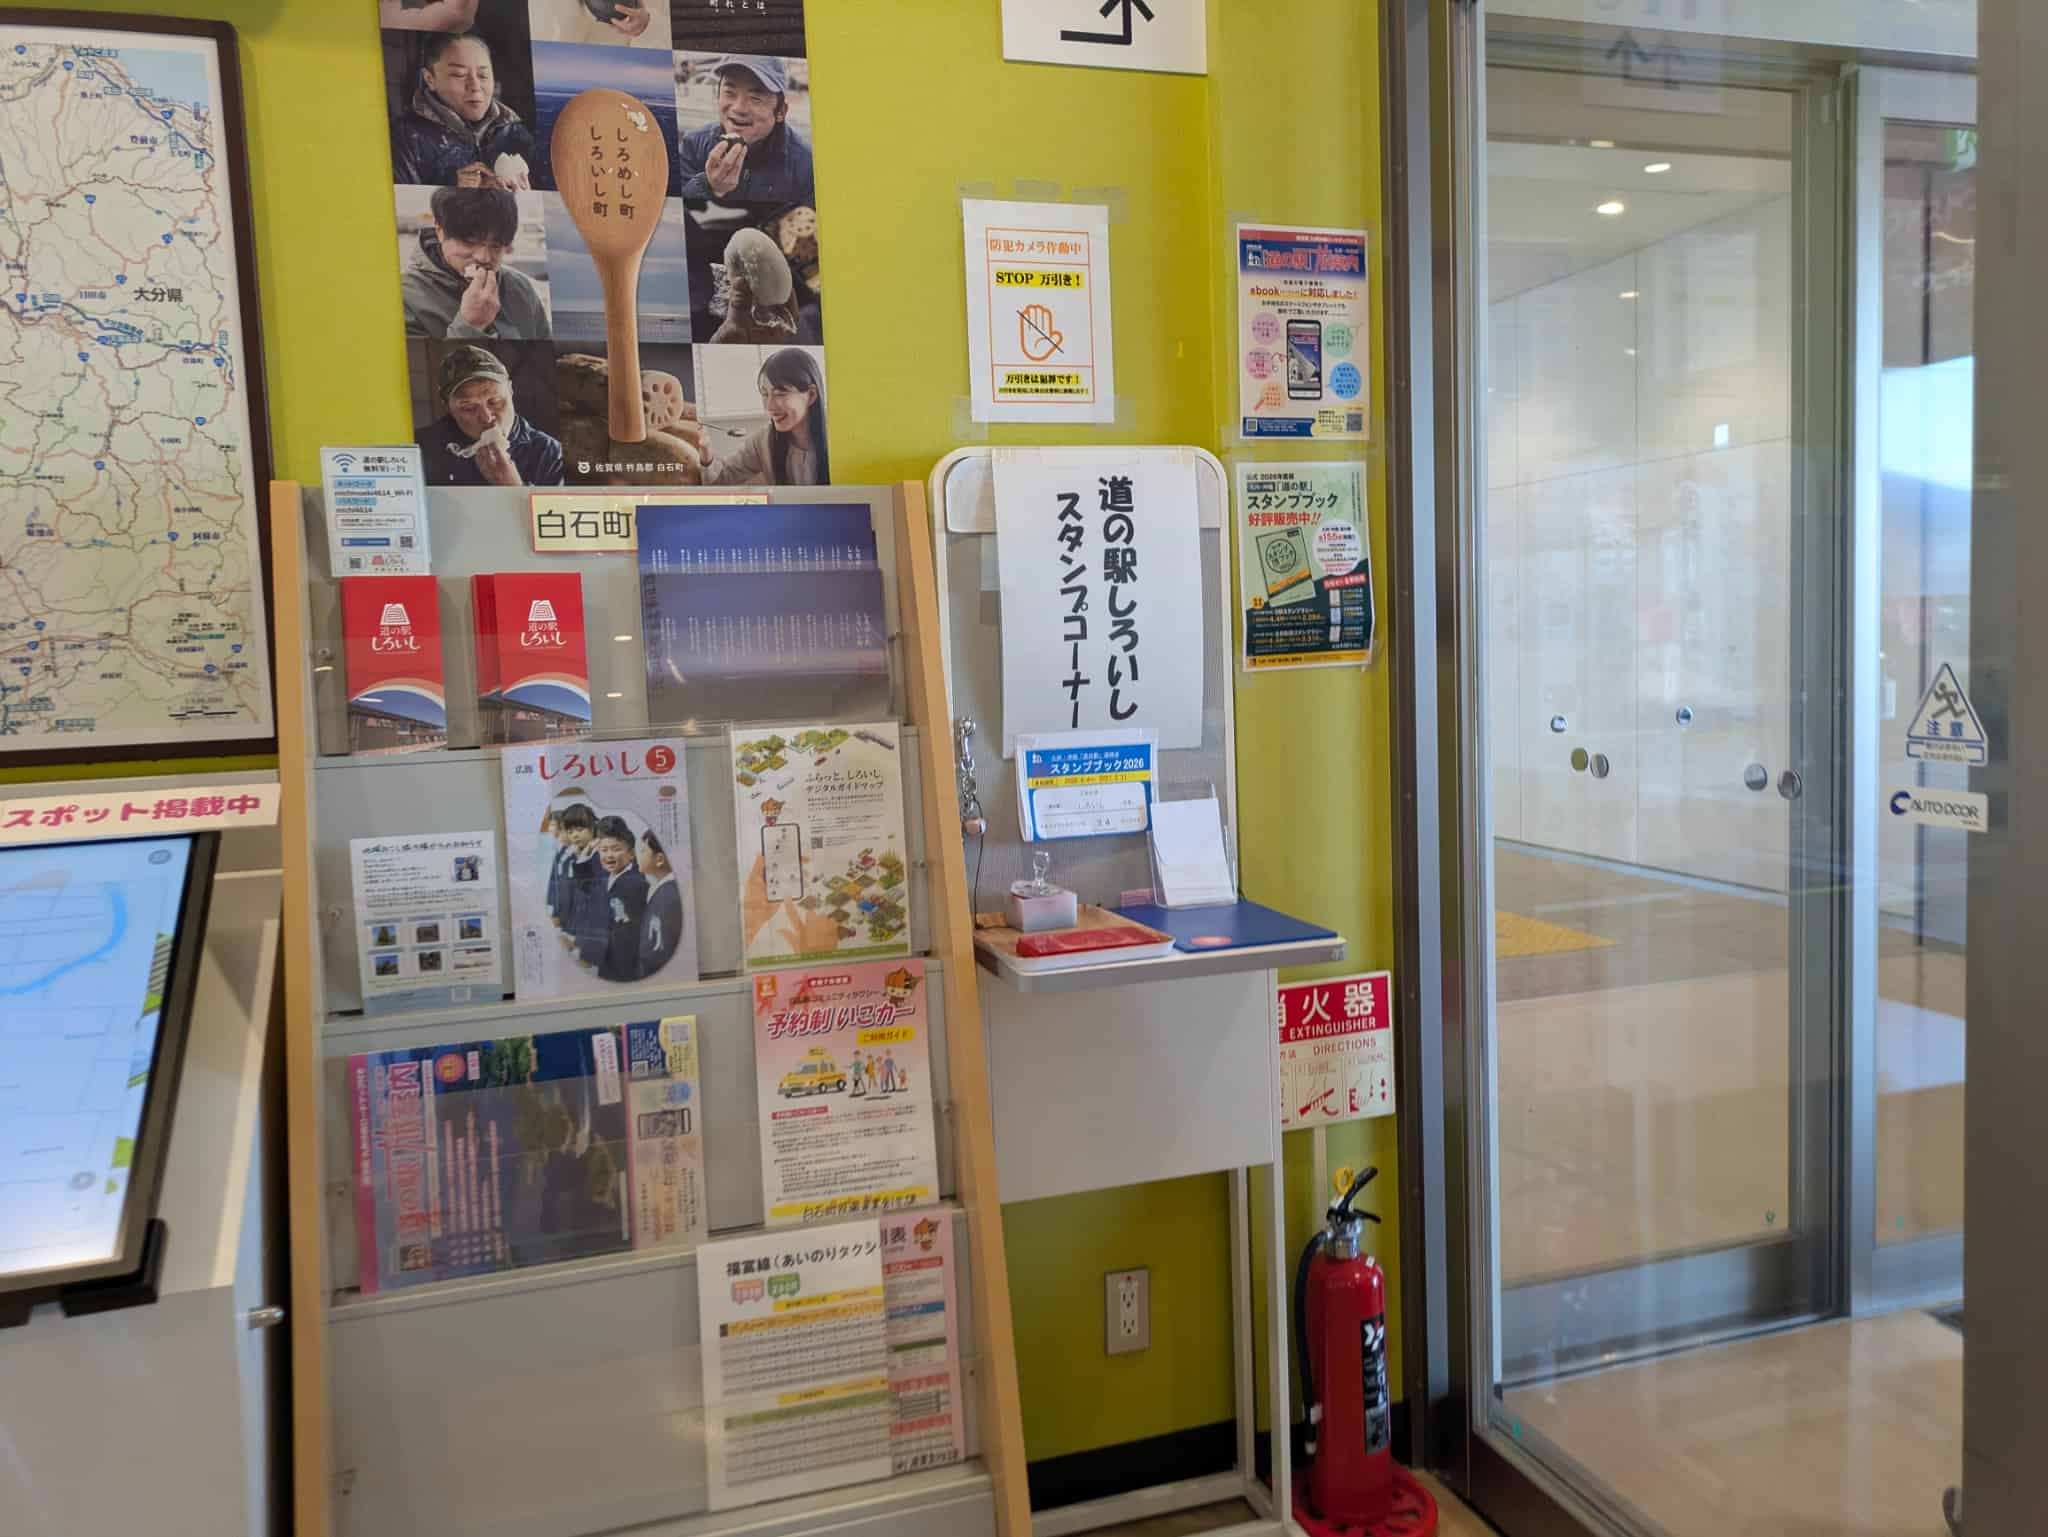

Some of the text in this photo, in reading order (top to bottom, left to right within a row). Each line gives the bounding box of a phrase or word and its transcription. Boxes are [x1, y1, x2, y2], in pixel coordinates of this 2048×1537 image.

[590, 126, 608, 218] しろいし町
[617, 128, 635, 220] しろめし町
[990, 239, 1081, 256] 防犯カメラ作動中
[995, 271, 1081, 287] STOP 万引き！
[133, 287, 183, 303] 大分県
[595, 462, 623, 473] 佐賀県
[657, 462, 684, 473] 白石町
[1248, 493, 1338, 509] スタンプブック
[537, 509, 632, 539] 白石町
[1098, 475, 1139, 720] 道の駅しろいし
[1056, 492, 1091, 729] スタンプコーナー
[379, 626, 411, 636] 道の駅
[528, 622, 558, 632] 道の駅
[371, 638, 421, 651] しろいし
[520, 632, 567, 647] しろいし
[539, 750, 667, 781] しろいし 5
[1050, 757, 1145, 774] スタンプブック2026
[2, 794, 261, 829] スポット掲載中
[1289, 1016, 1376, 1040] EXTINGUISHER
[1313, 1036, 1377, 1056] DIRECTIONS
